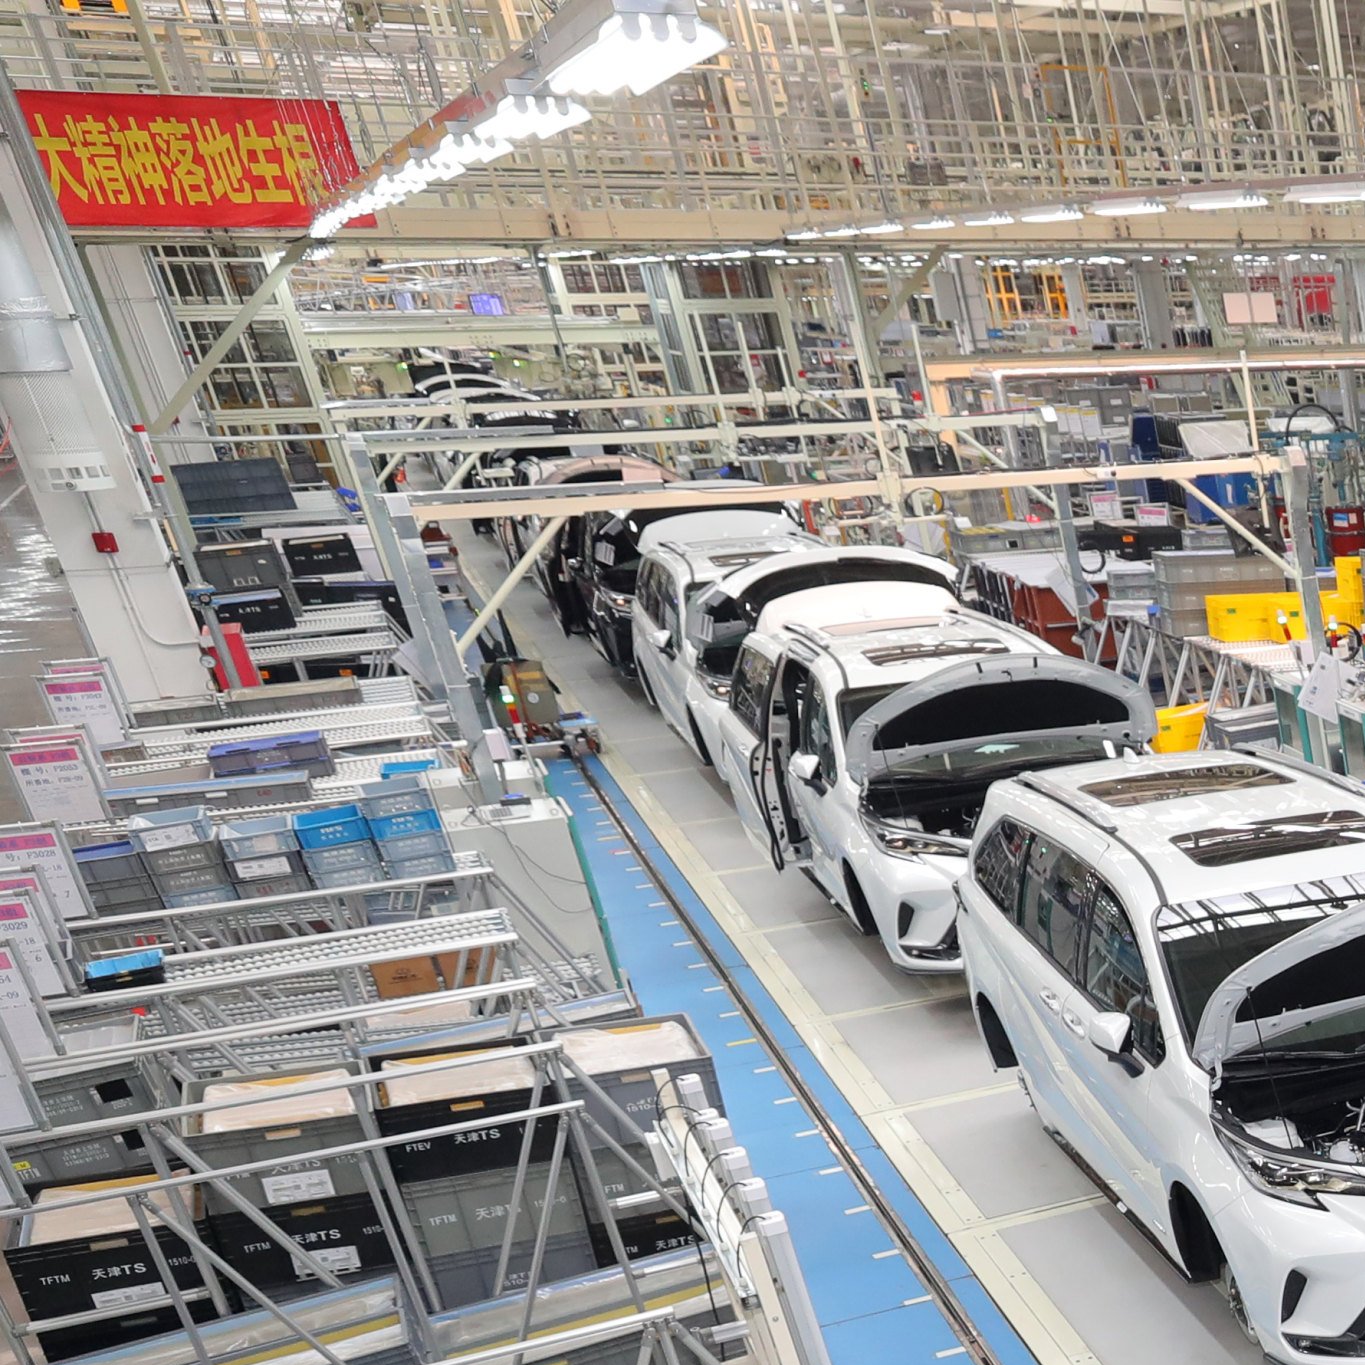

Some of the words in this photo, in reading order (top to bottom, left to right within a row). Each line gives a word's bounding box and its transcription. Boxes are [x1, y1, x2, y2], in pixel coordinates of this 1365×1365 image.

[405, 1141, 432, 1153] FTEV
[454, 1128, 501, 1144] 天津TS
[428, 1213, 458, 1226] TFTM
[475, 1203, 522, 1221] 天津T
[243, 1241, 272, 1253] TFTM
[291, 1228, 342, 1244] 天津TS
[39, 1273, 71, 1286] TFTM
[92, 1262, 147, 1280] 天津TS
